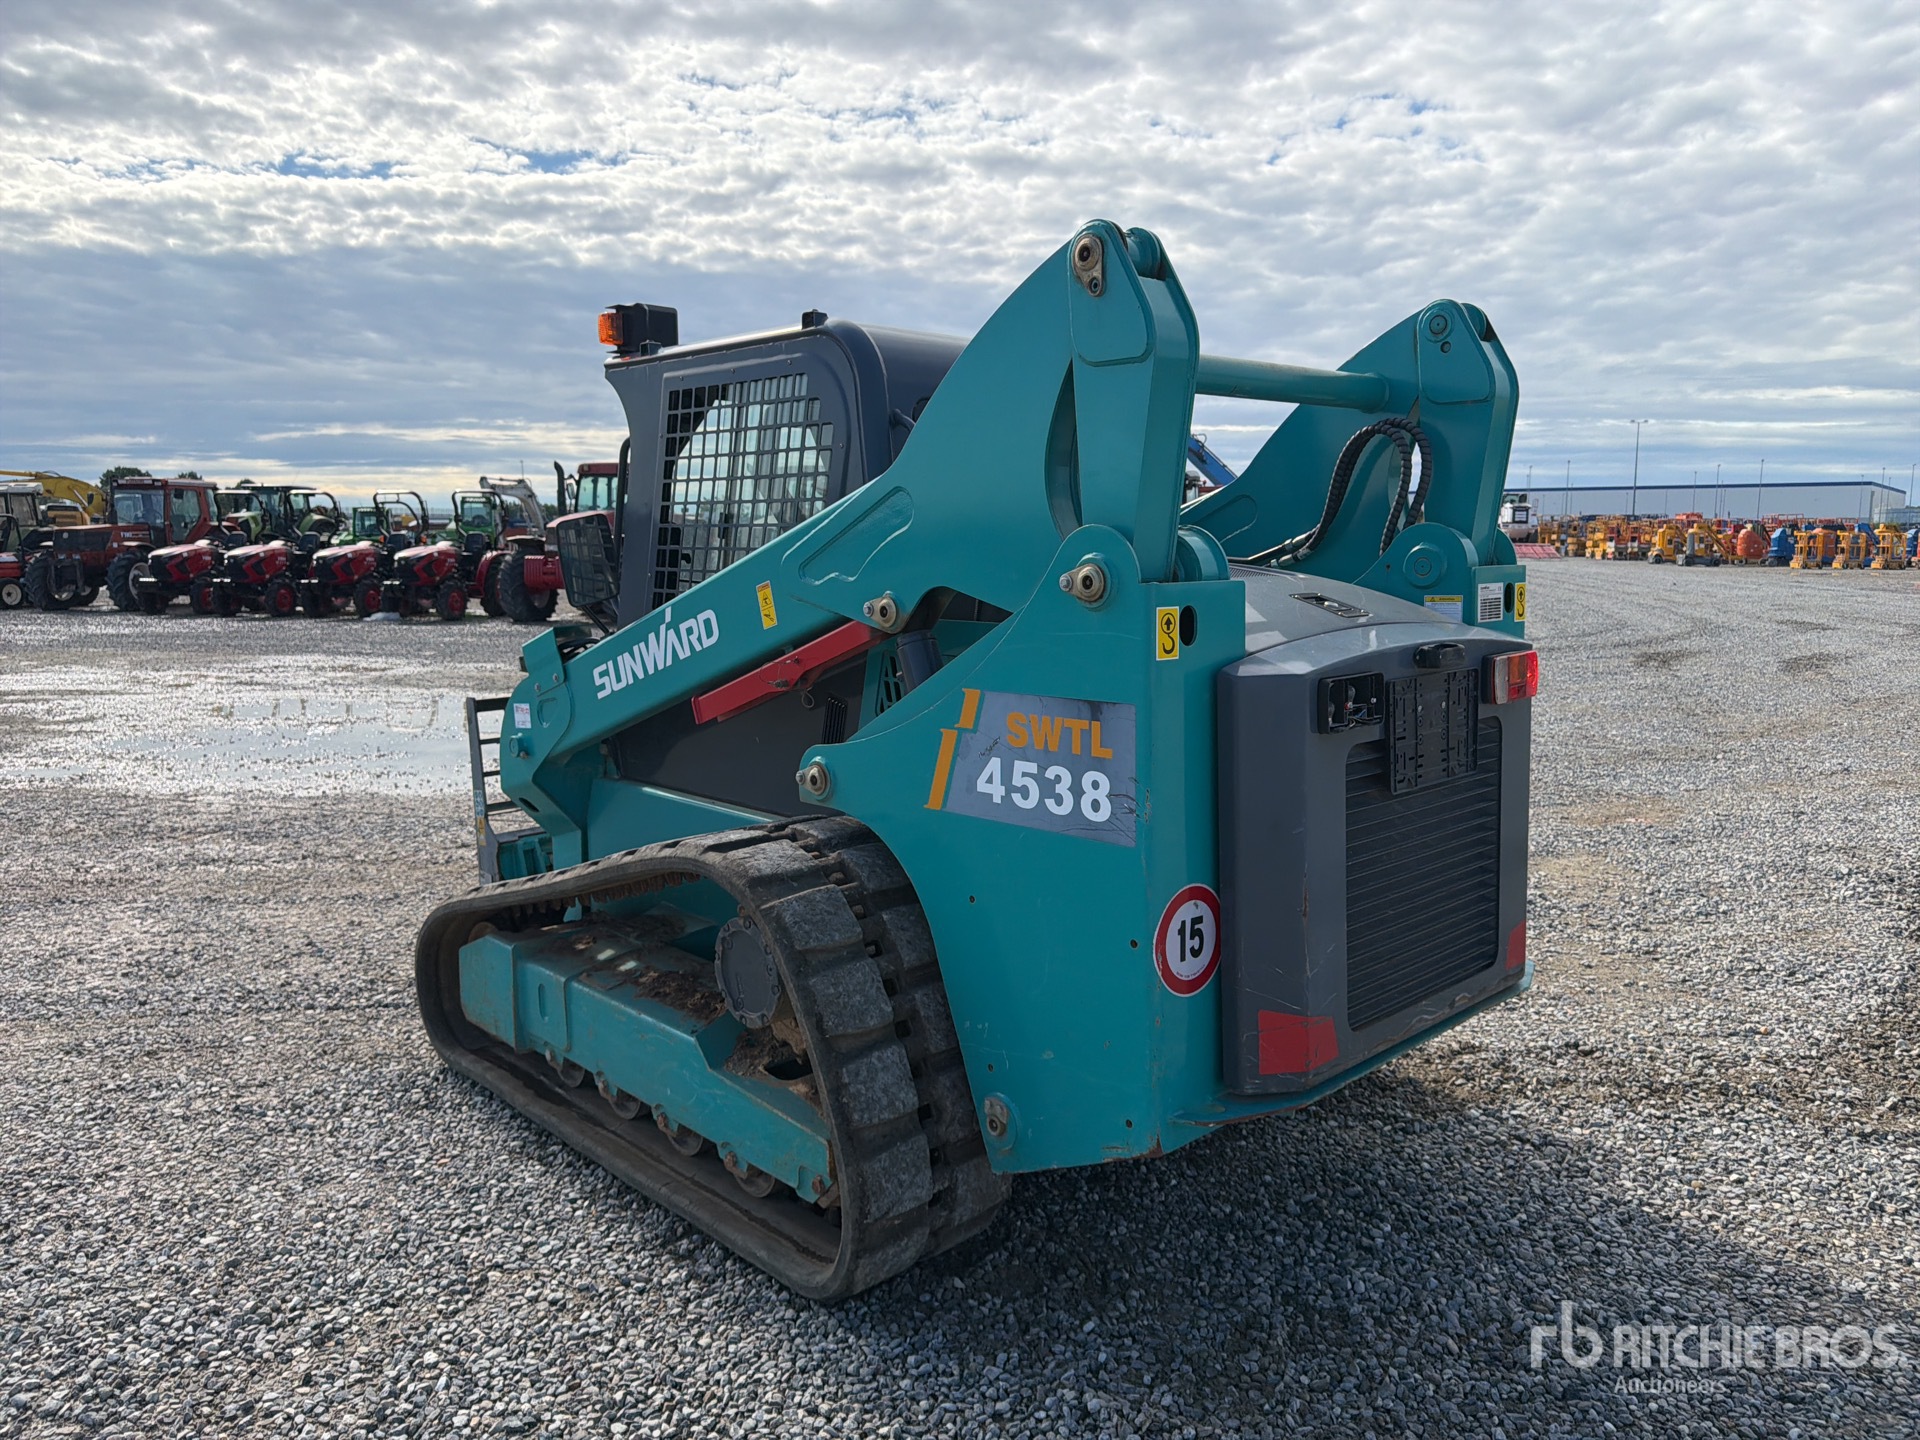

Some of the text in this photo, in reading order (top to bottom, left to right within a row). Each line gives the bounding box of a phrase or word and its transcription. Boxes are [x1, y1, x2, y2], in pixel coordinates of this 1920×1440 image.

[593, 606, 719, 699] SUNWARD
[1006, 712, 1113, 759] SWTL
[976, 756, 1112, 822] 4538
[1177, 915, 1204, 963] 15
